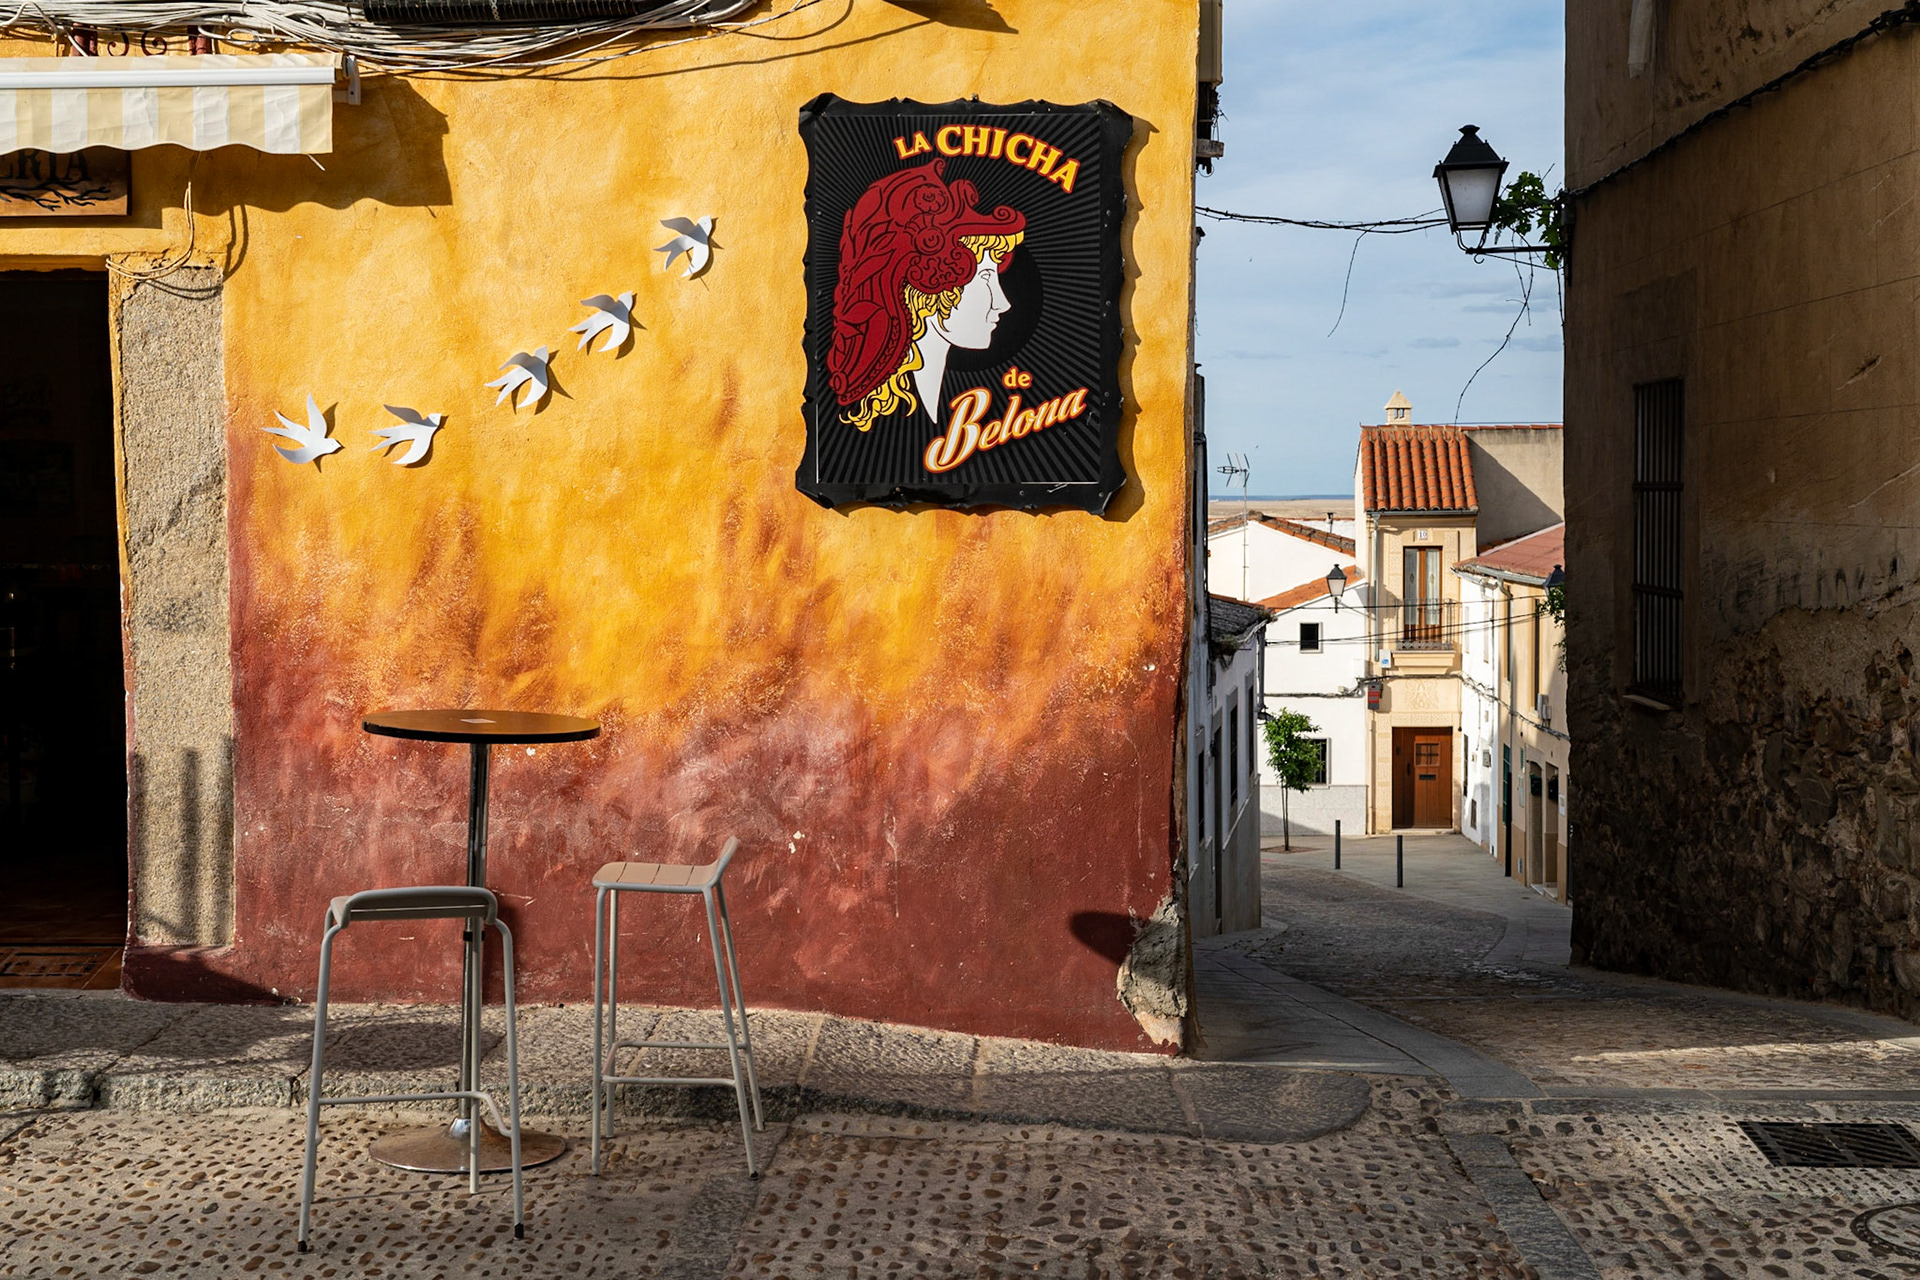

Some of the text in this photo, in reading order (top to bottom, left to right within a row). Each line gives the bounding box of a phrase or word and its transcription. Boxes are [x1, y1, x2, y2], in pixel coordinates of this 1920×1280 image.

[894, 124, 1081, 194] LA CHICHA
[1002, 366, 1033, 389] de
[923, 386, 1089, 474] Belona
